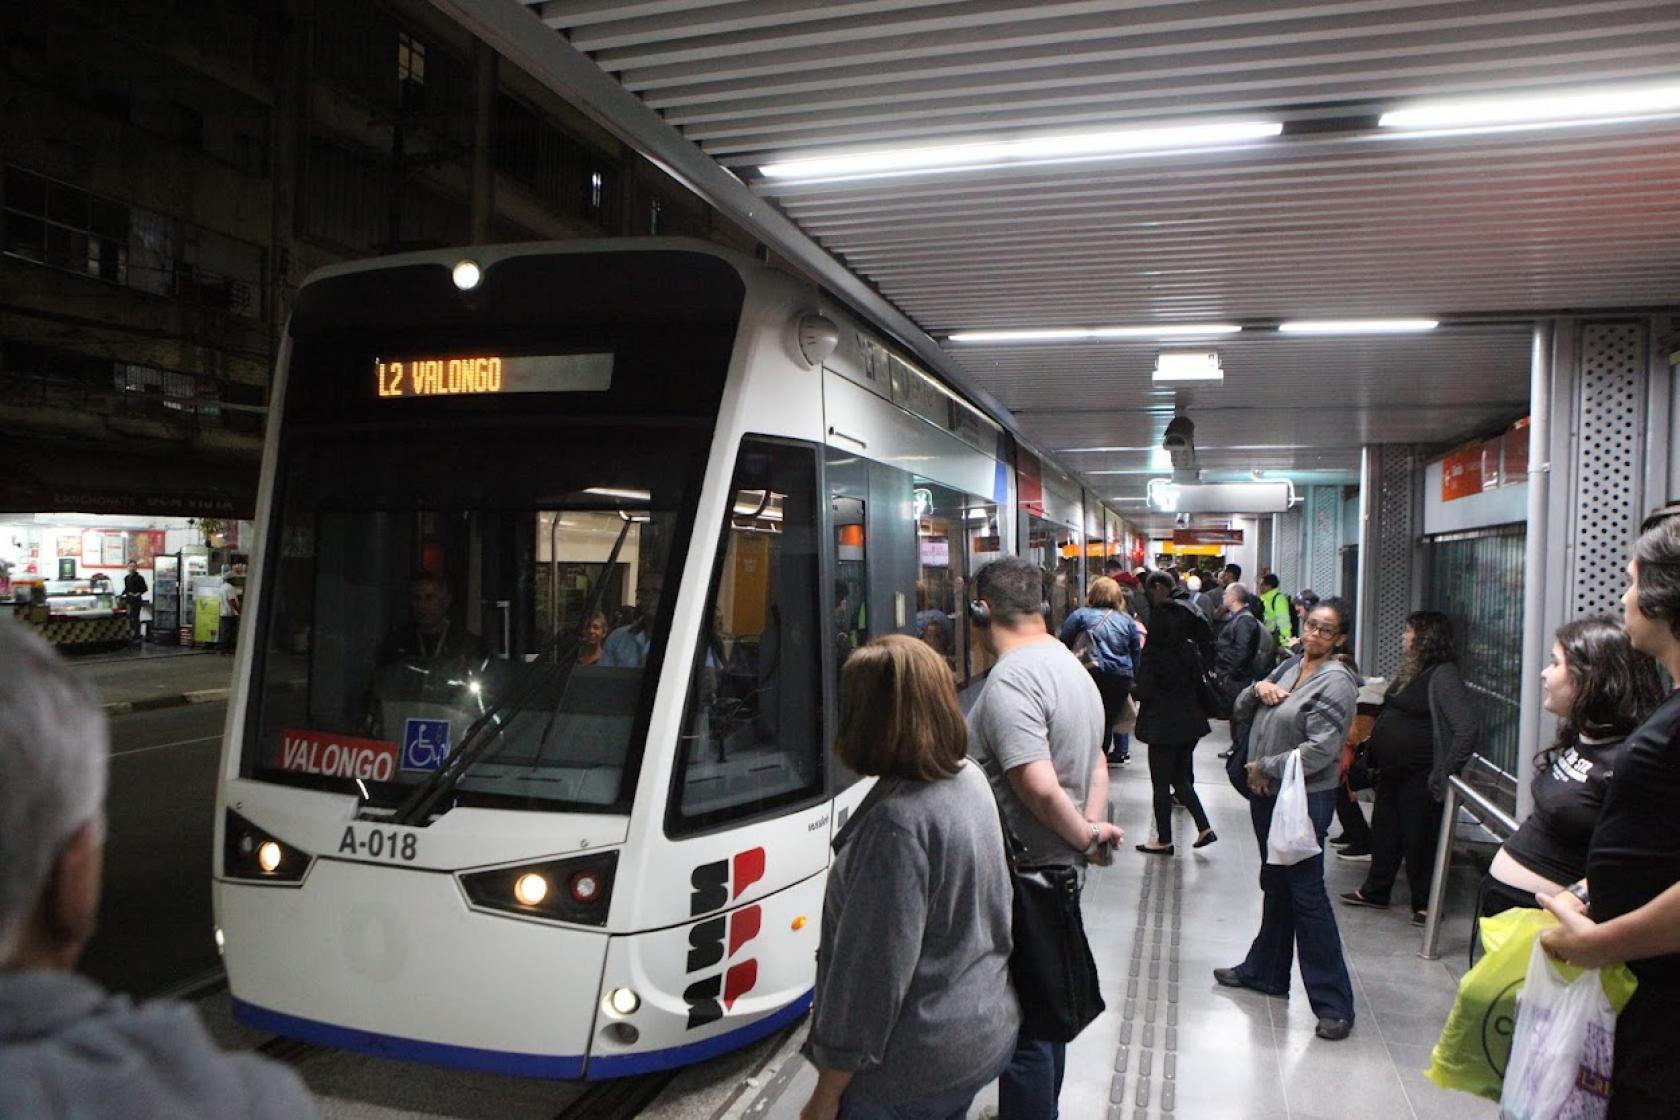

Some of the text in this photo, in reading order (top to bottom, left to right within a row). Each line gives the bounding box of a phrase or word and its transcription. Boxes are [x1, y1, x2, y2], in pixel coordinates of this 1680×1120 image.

[379, 357, 501, 396] L2 VALONGO
[284, 737, 392, 781] VALONGO
[338, 826, 418, 861] A-018
